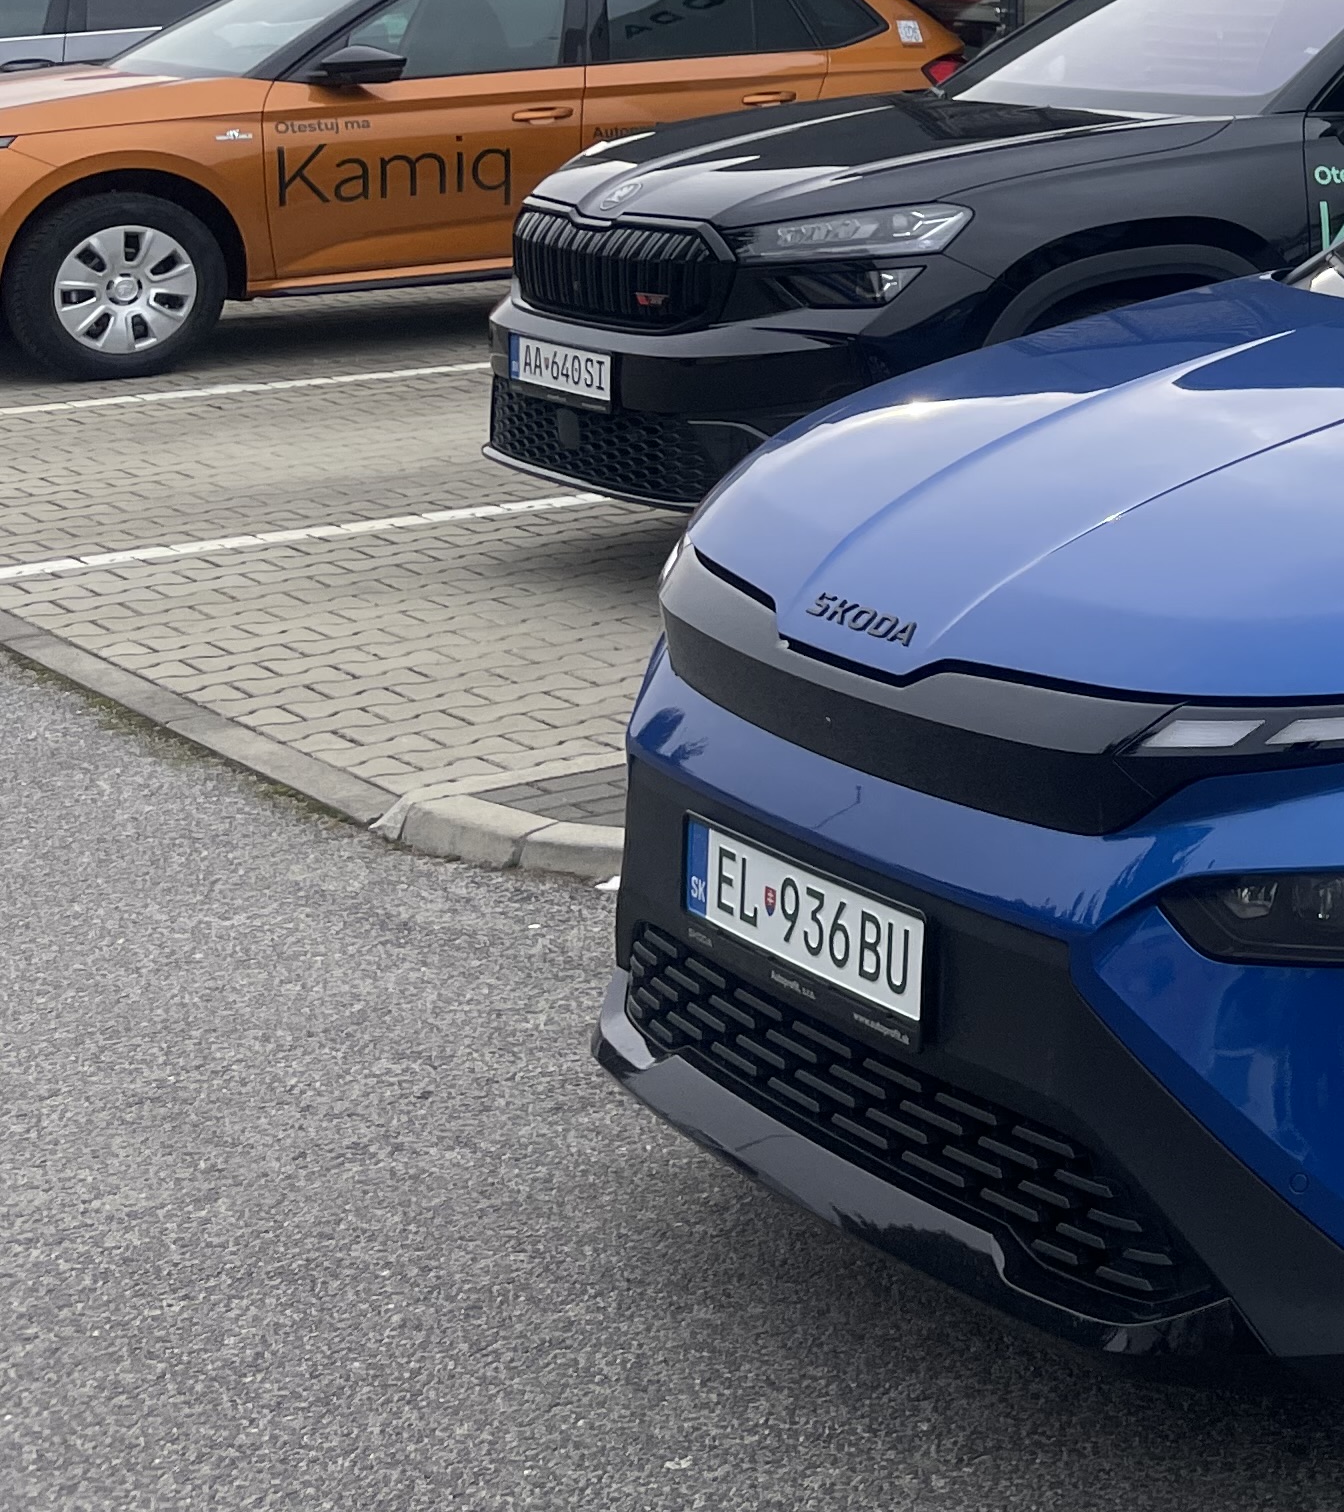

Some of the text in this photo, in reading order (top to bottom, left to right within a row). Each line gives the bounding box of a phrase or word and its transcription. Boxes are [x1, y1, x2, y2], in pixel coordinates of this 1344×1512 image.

[274, 118, 371, 134] Otestuj ma
[277, 135, 511, 207] Kamiq
[691, 875, 706, 903] SK
